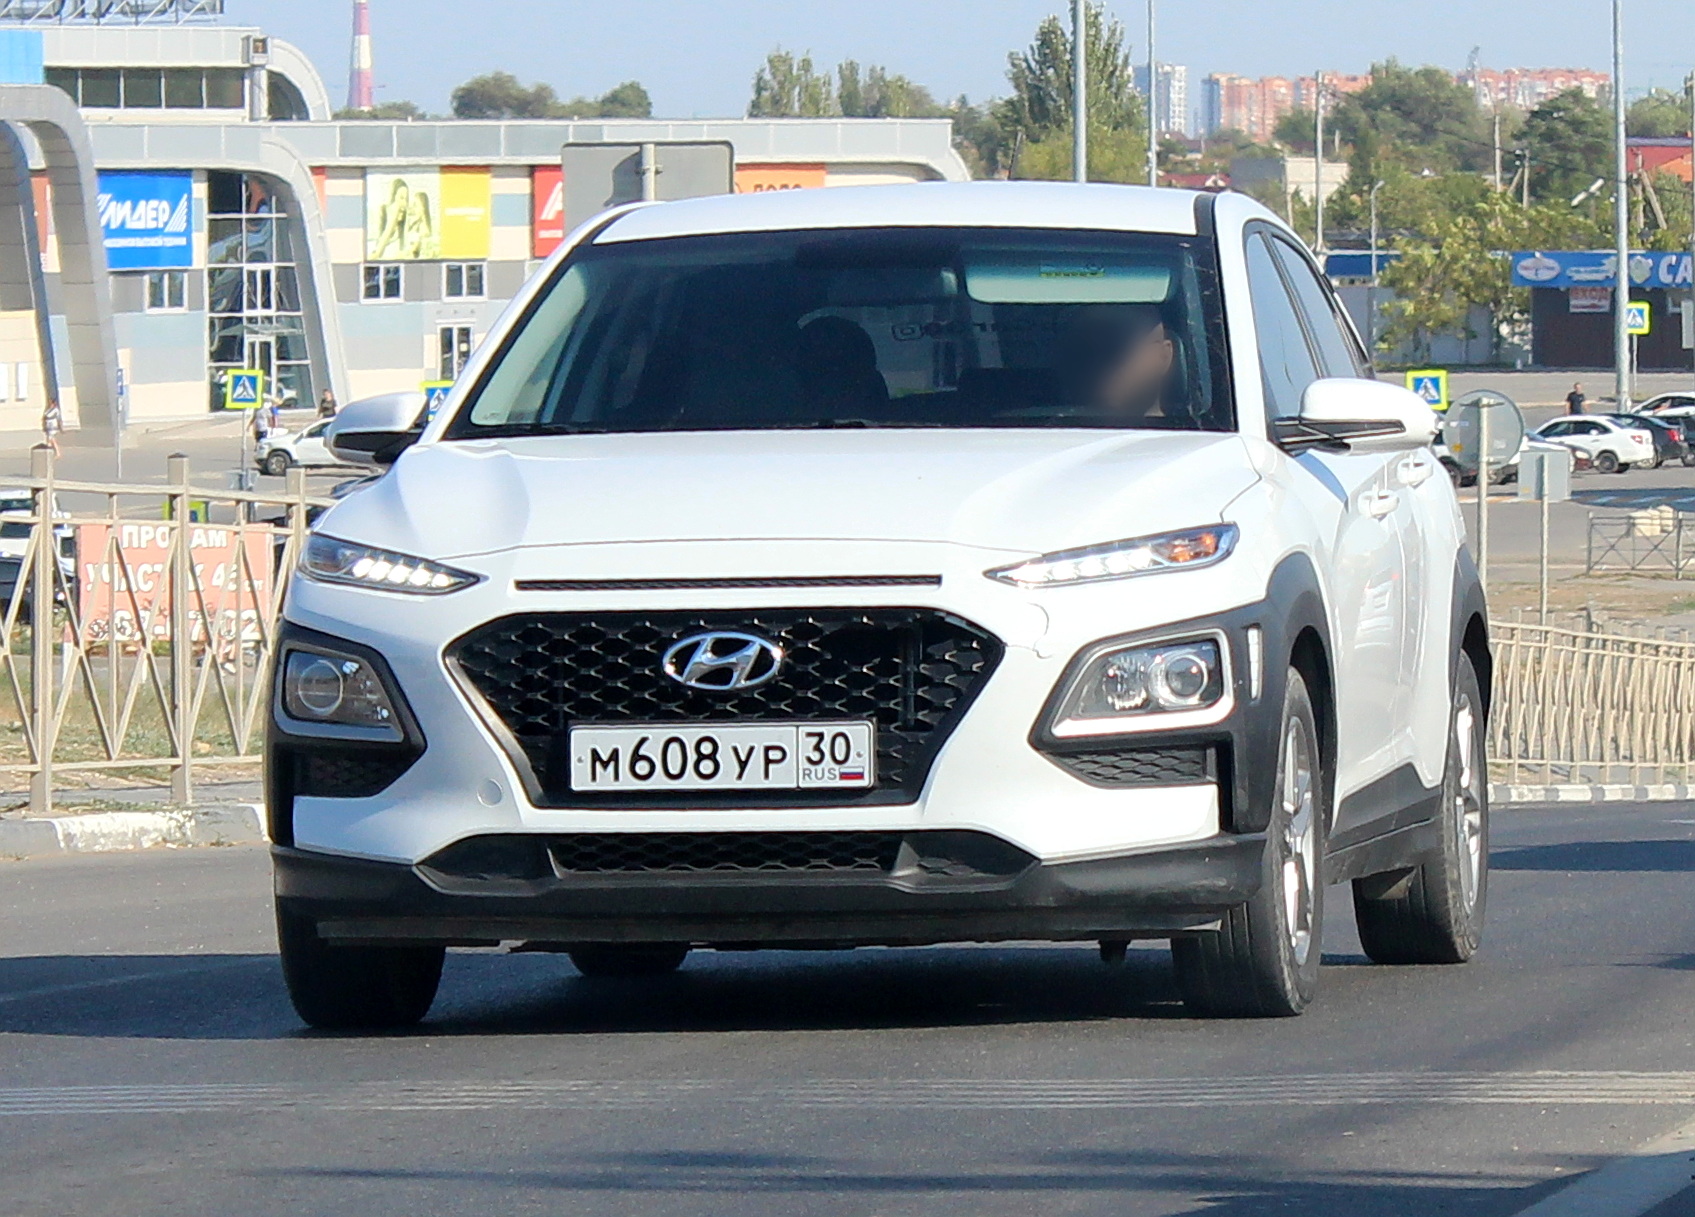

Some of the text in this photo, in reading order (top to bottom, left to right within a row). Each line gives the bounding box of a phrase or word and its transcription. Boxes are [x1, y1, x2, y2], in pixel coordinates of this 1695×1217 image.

[100, 198, 171, 231] ЛИДЕР
[121, 525, 228, 549] ПРОАМ
[85, 563, 205, 592] УЧАСТК
[589, 731, 852, 783] М608УР 30
[802, 767, 838, 781] RUS
